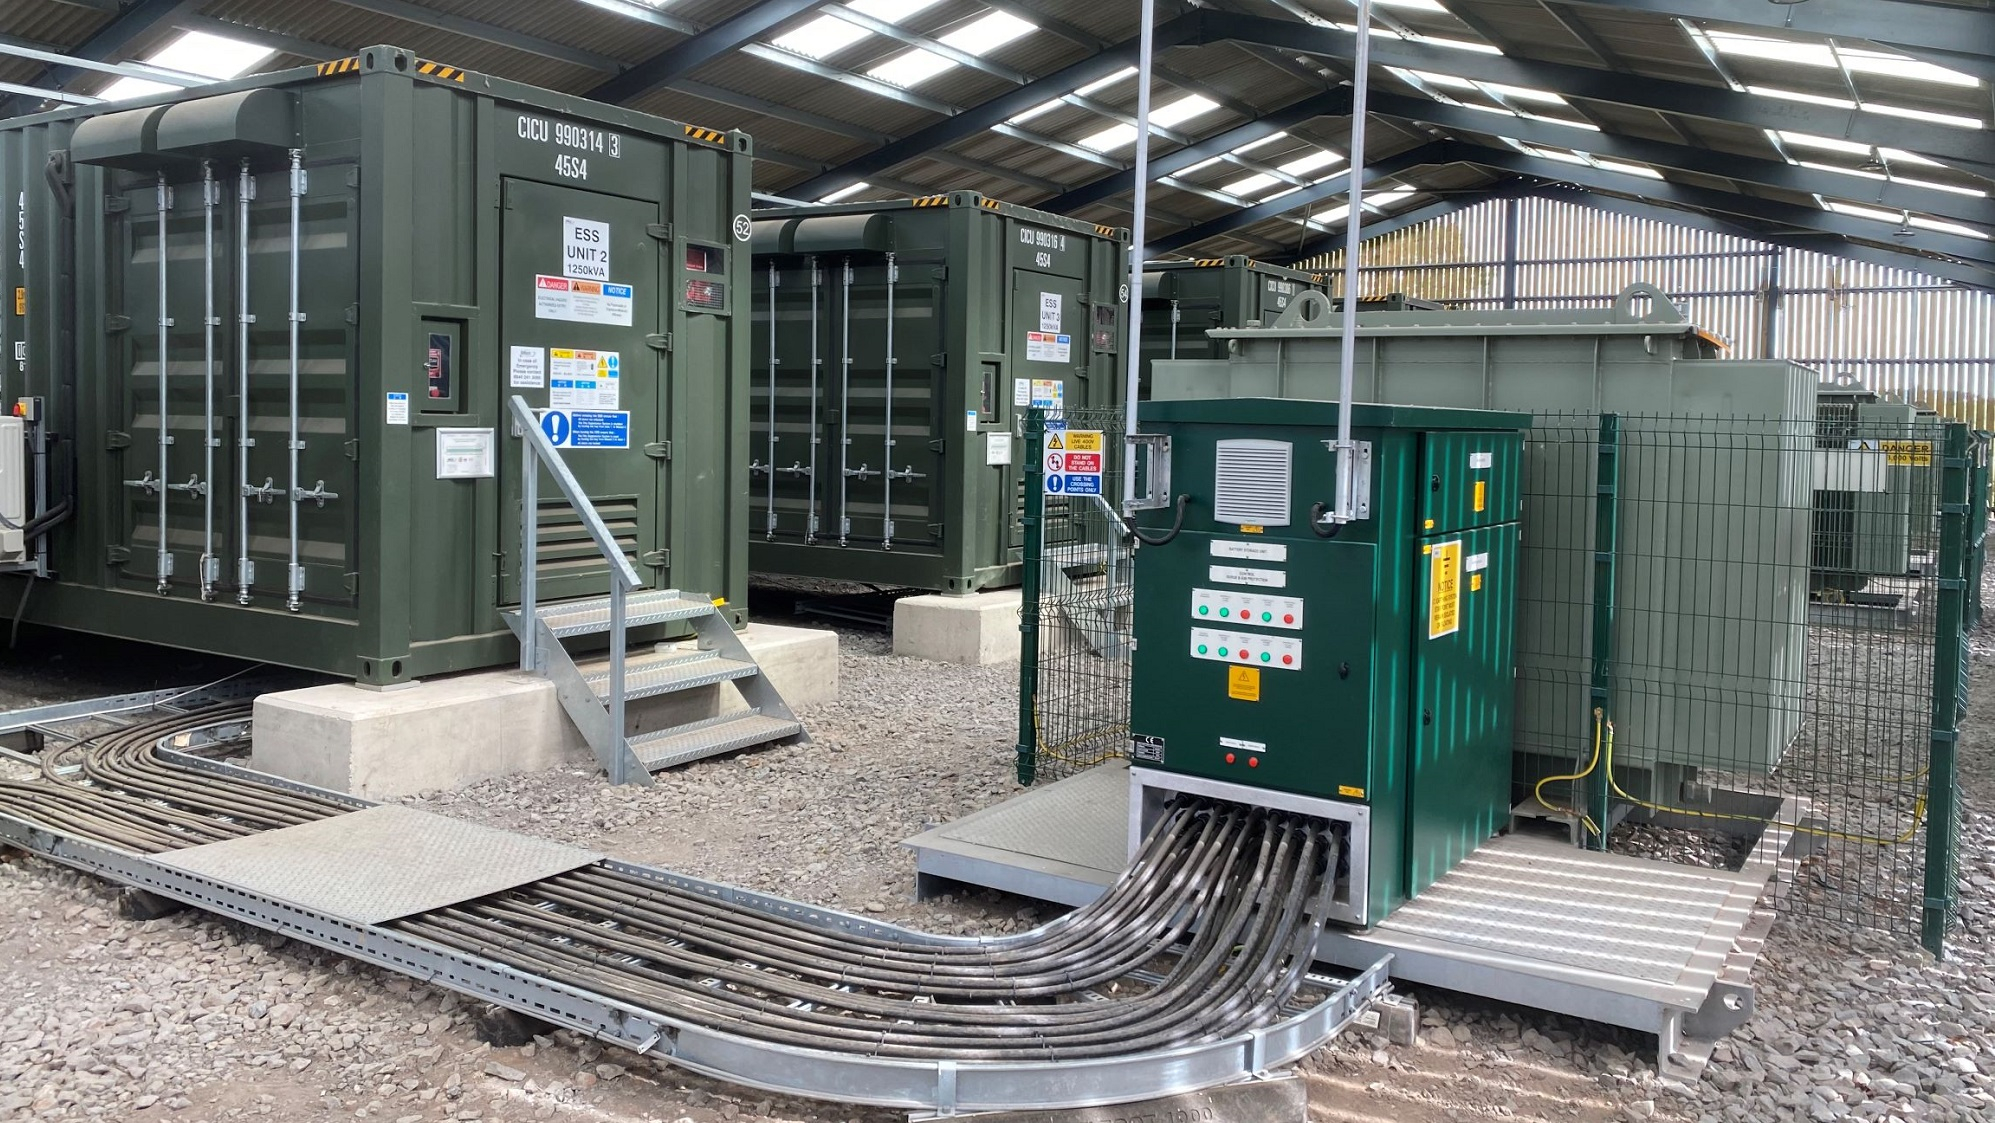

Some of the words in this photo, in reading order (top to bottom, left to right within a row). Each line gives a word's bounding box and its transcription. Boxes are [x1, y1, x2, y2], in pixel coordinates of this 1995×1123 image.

[517, 115, 549, 143] CICU
[555, 122, 604, 154] 990314
[610, 134, 619, 157] 3
[554, 153, 588, 180] 45S4
[575, 227, 600, 243] ESS
[736, 220, 750, 236] 52
[1020, 228, 1035, 245] CICU
[567, 245, 597, 261] UNIT
[600, 250, 608, 263] 2
[567, 263, 606, 277] 1250kVA
[546, 280, 567, 291] DANGER
[607, 286, 627, 295] NOTICE
[1045, 298, 1057, 309] ESS
[1041, 311, 1055, 321] UNIT
[1882, 444, 1929, 453] DANGER
[1437, 578, 1454, 592] NOTICE
